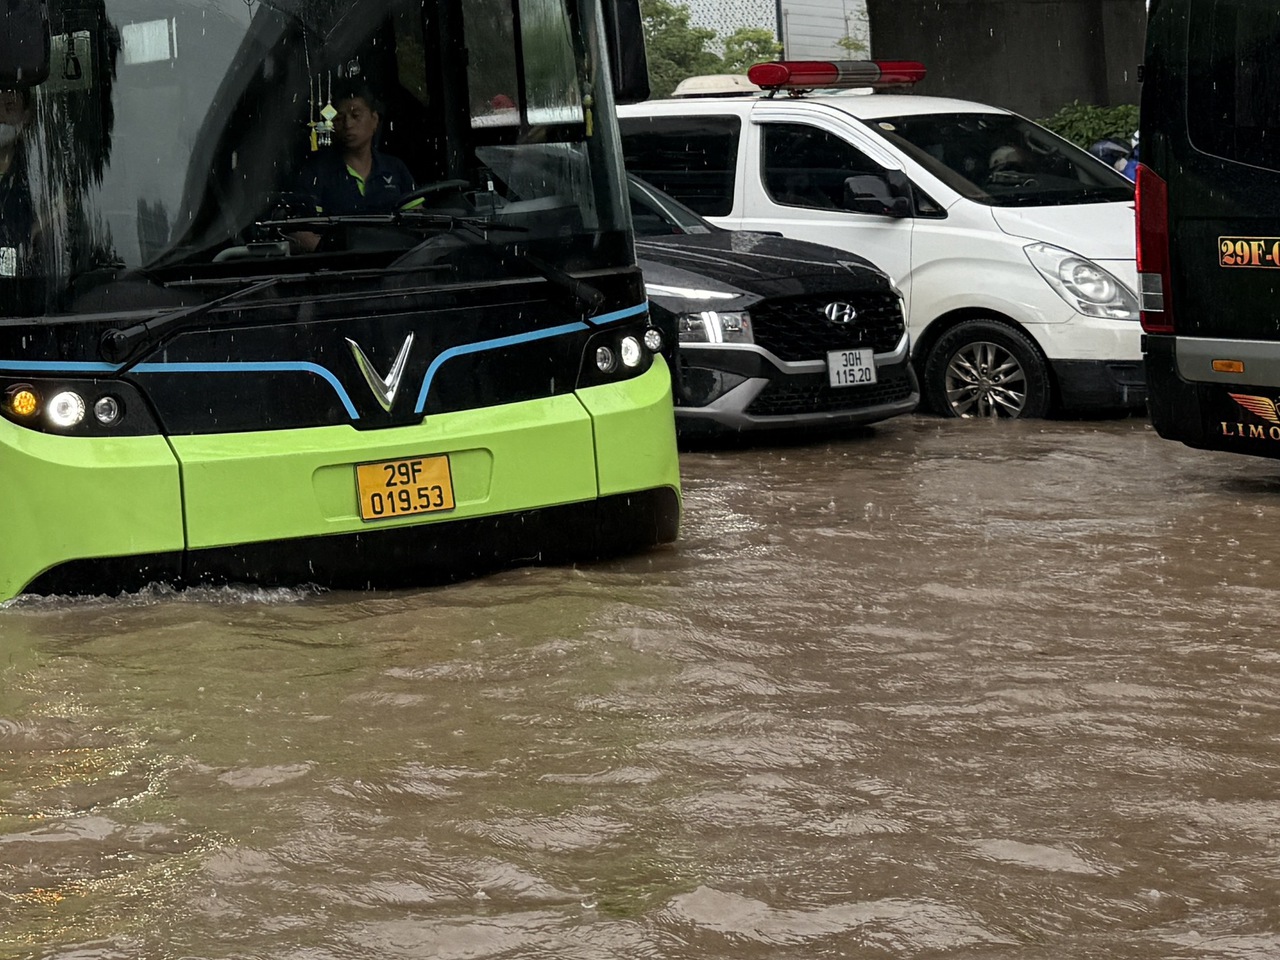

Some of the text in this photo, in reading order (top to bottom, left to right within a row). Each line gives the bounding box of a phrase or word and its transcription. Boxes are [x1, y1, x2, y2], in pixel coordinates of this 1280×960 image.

[841, 351, 862, 368] 30H
[836, 367, 872, 385] 115.20
[1221, 421, 1280, 441] LIMO
[383, 460, 423, 488] 29F
[370, 485, 444, 515] 019.53
